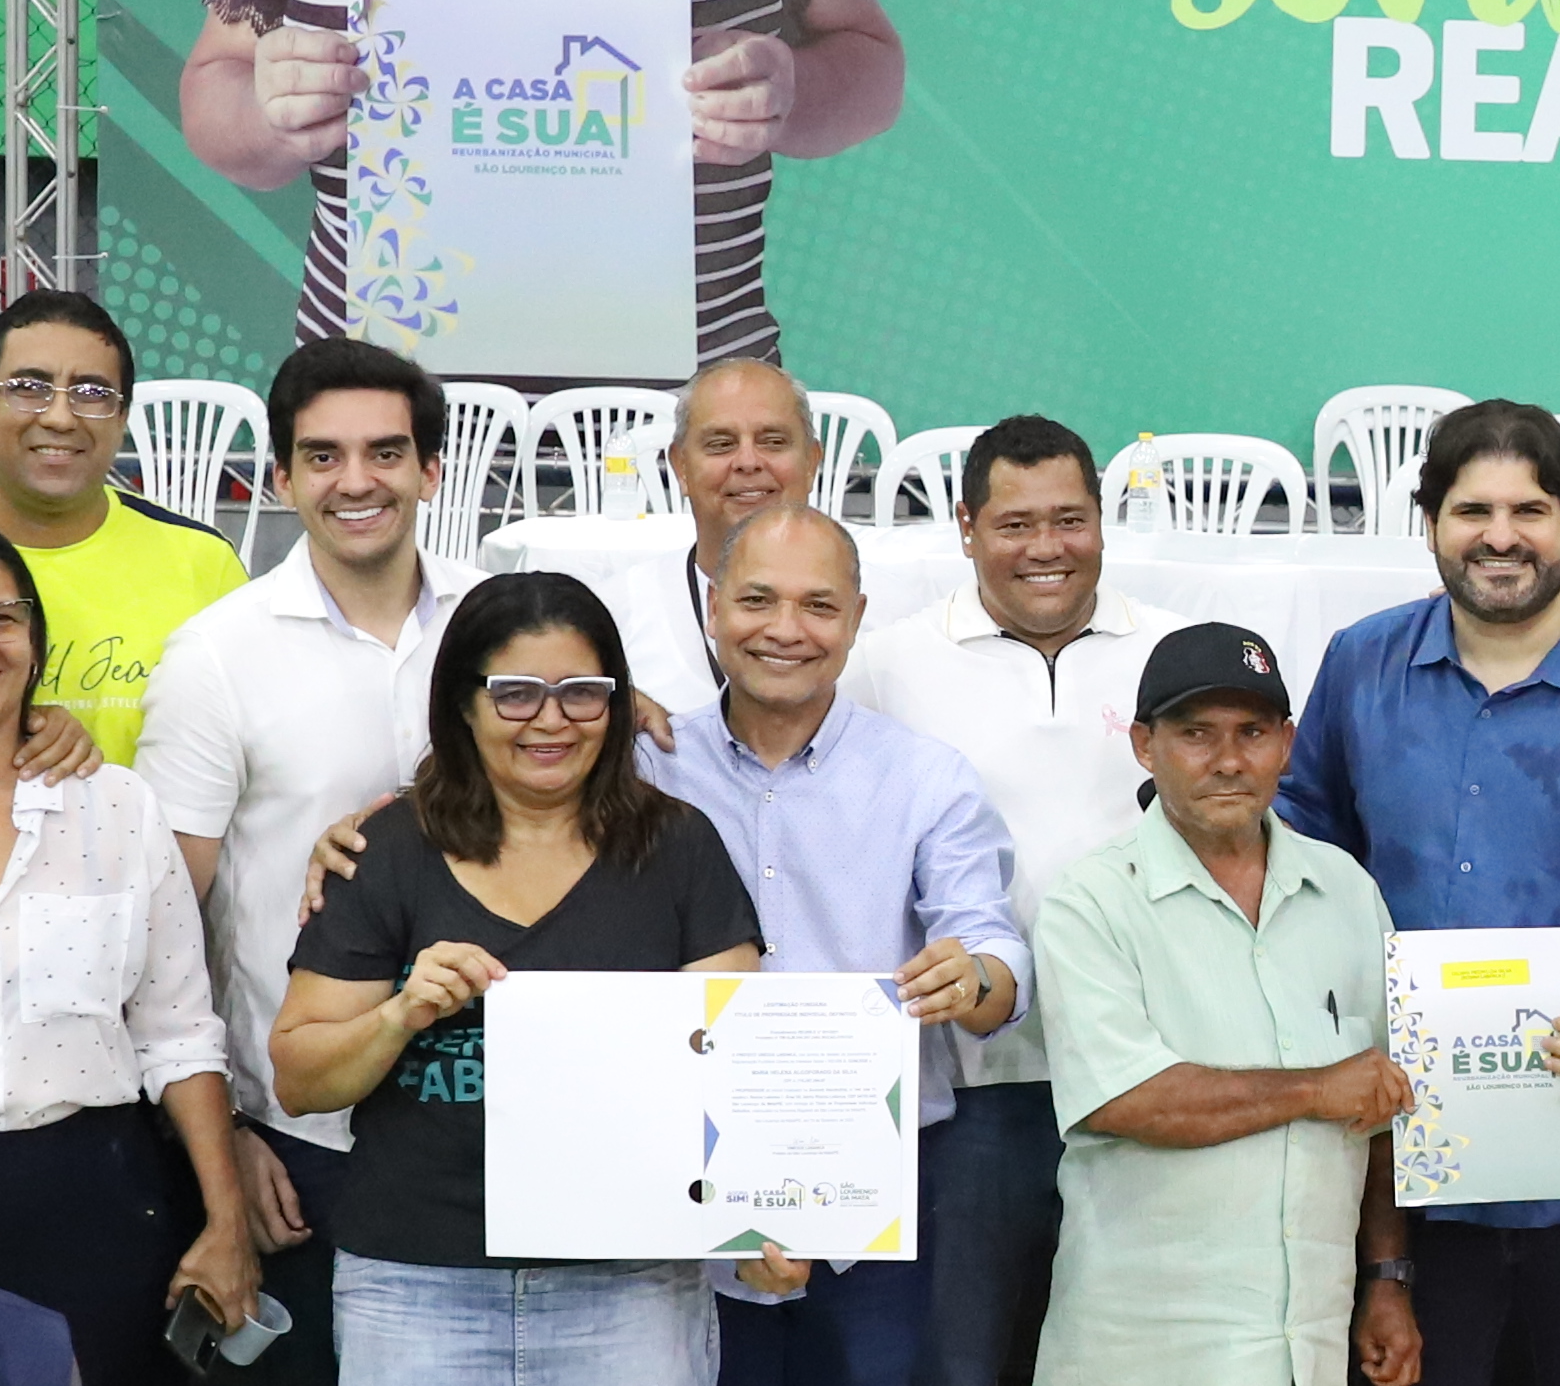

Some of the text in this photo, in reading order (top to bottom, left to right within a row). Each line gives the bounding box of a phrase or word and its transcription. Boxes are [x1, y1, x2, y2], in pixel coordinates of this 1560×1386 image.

[452, 77, 574, 103] A CASA
[451, 101, 616, 148] É SUA
[451, 147, 617, 161] REURBANIZAÇÃO MUNICIPAL
[473, 162, 624, 178] SÃO LOURENÇO DA MATA
[80, 636, 160, 691] Jea
[1452, 1034, 1523, 1049] A CASA
[1451, 1049, 1549, 1075] É SUA
[766, 1197, 798, 1208] SUA
